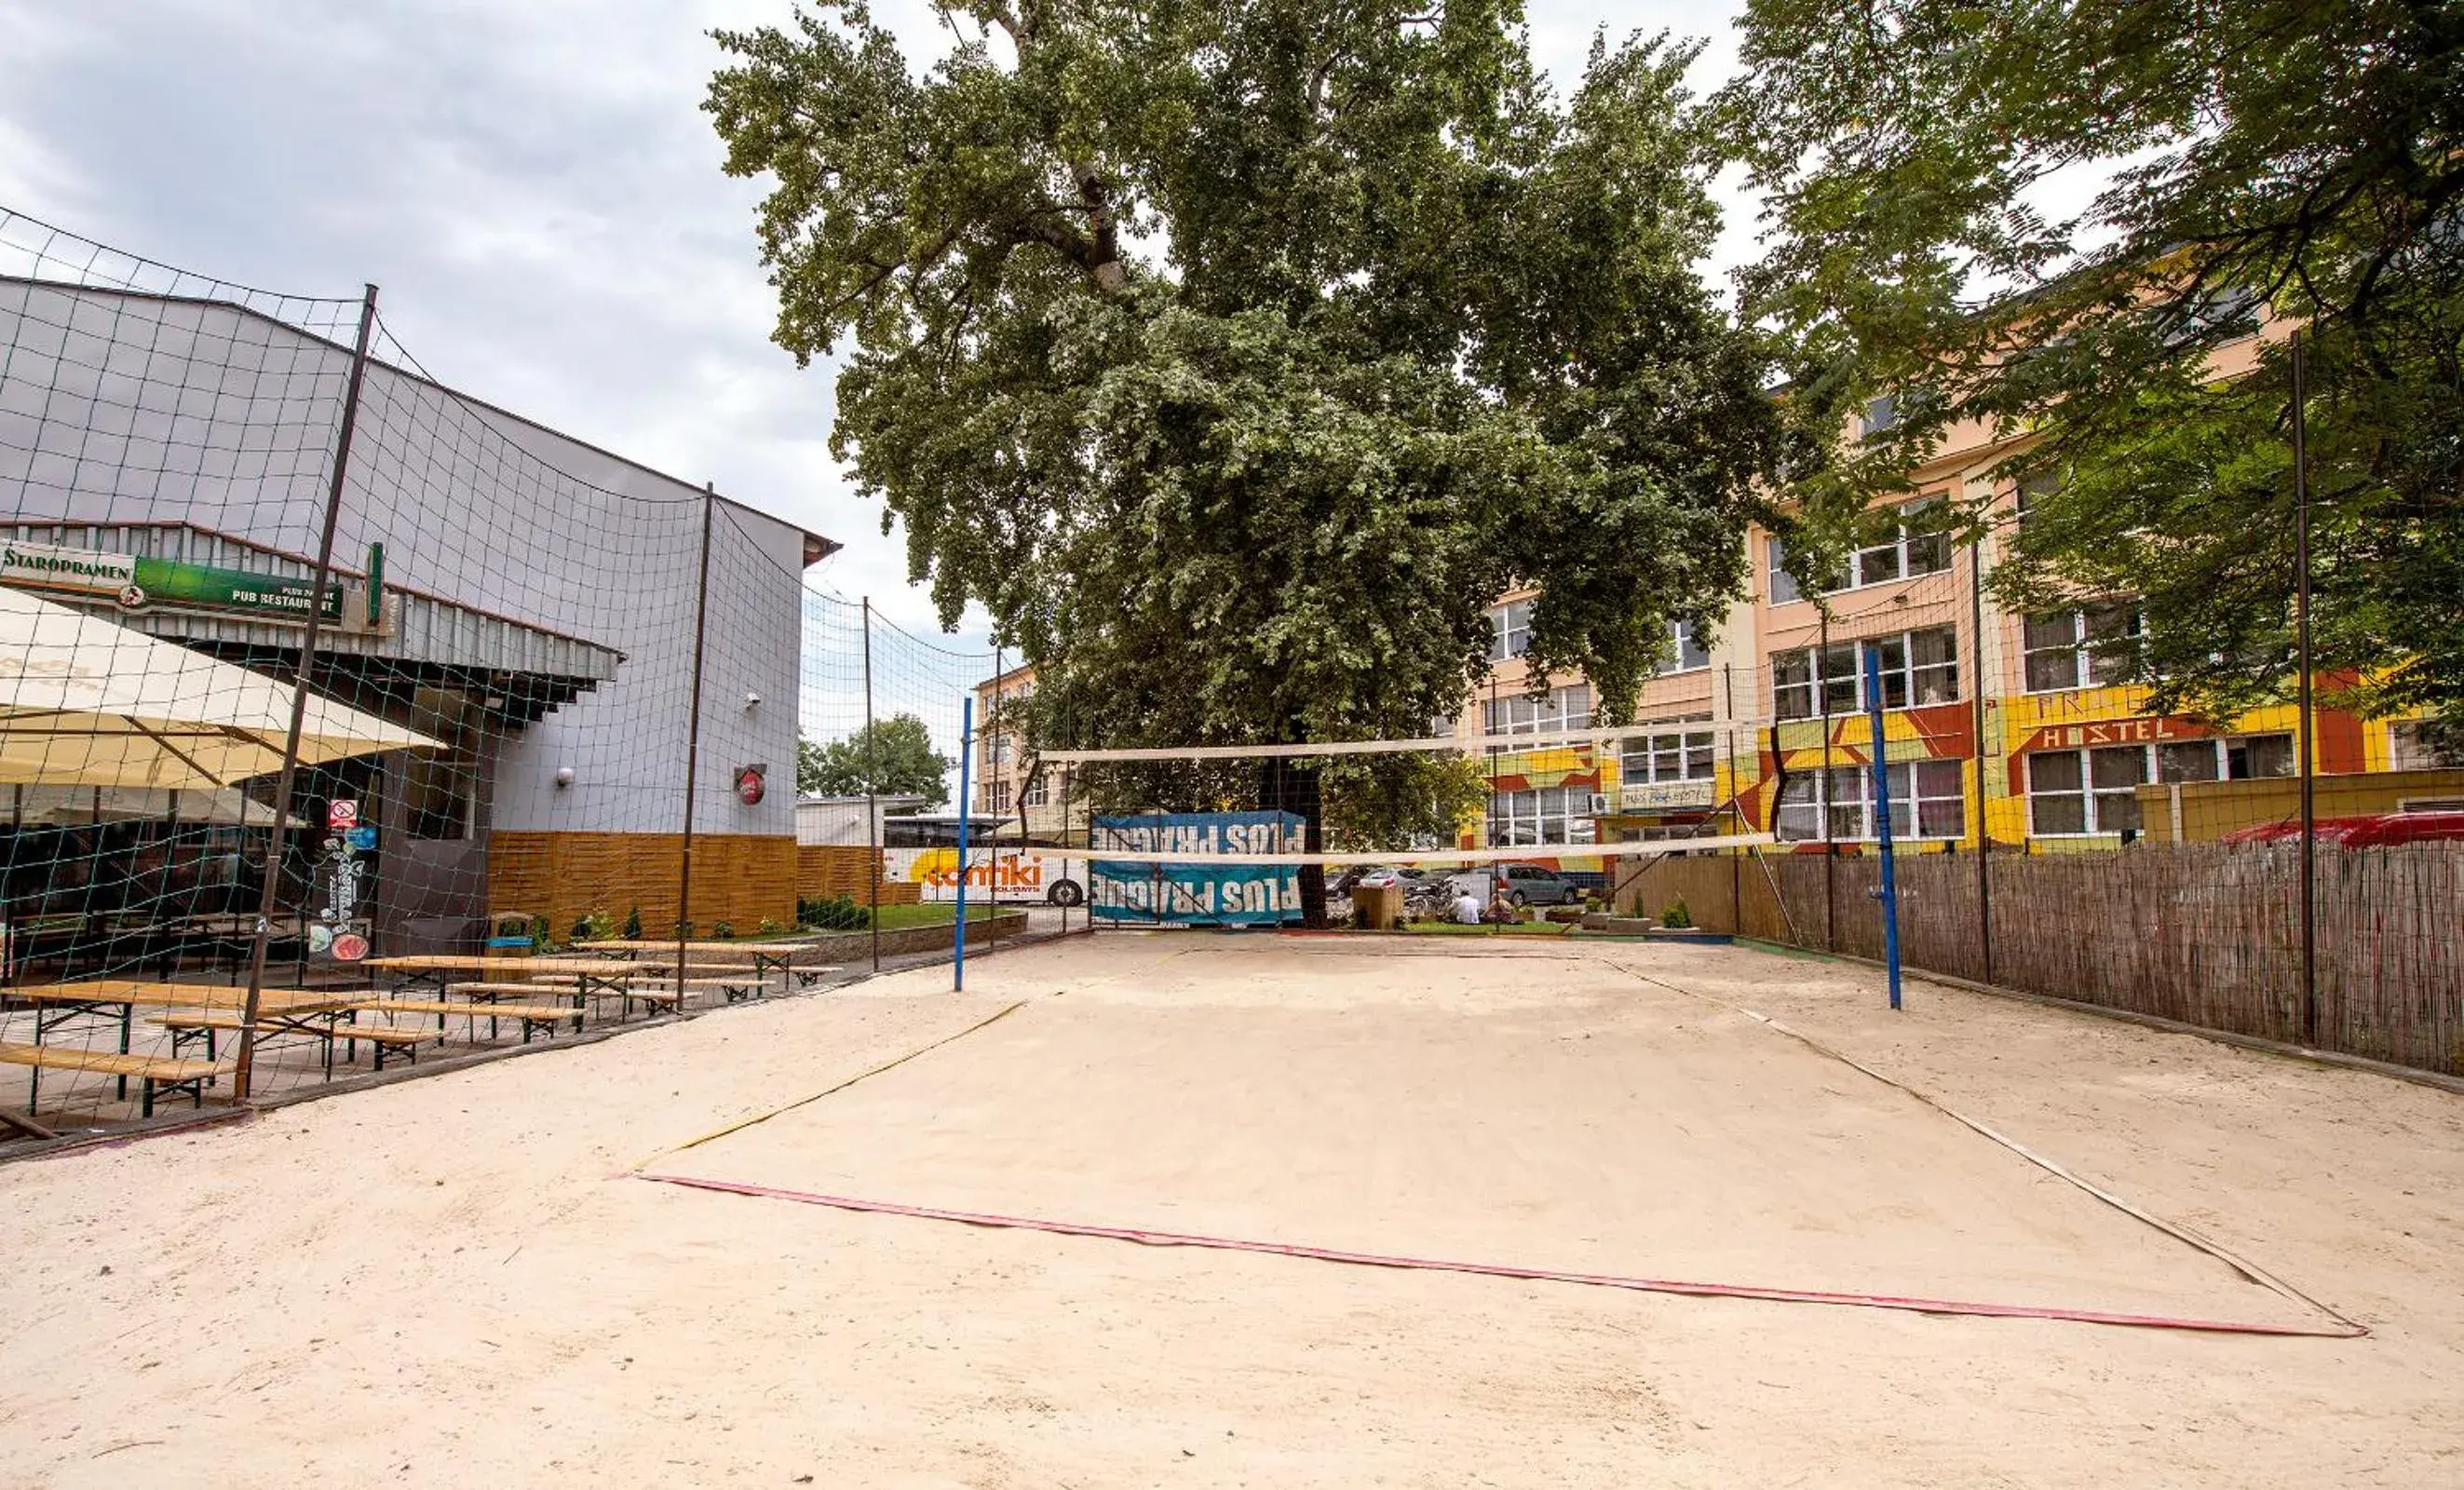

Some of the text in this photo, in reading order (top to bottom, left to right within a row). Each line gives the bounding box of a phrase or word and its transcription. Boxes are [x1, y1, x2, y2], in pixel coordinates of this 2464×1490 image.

[4, 548, 129, 579] STAROPRAMEN
[233, 589, 333, 611] PUB RESTAURNT
[2044, 718, 2173, 747] HOSTEL
[1092, 822, 1306, 854] PLUS PRAGUE
[927, 854, 1041, 886] contiki
[1092, 874, 1302, 914] PLUS PRAGUE
